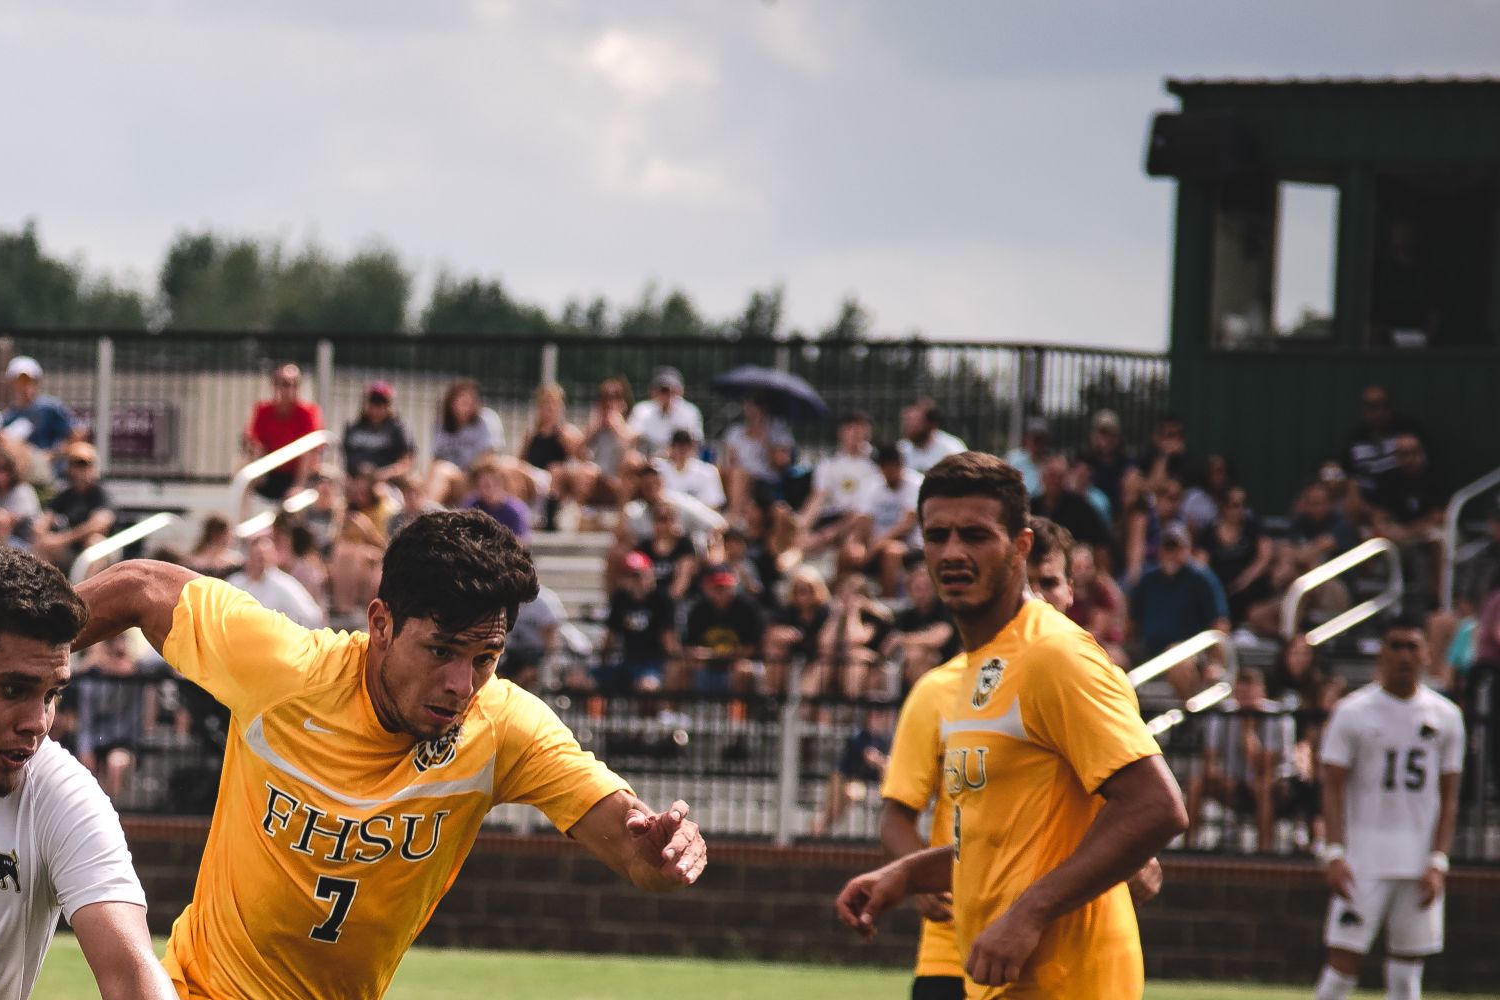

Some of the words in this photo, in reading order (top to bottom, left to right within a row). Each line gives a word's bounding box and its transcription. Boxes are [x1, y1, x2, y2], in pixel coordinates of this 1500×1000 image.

[1382, 747, 1426, 793] 15
[261, 780, 450, 865] FHSU
[308, 874, 360, 944] 7
